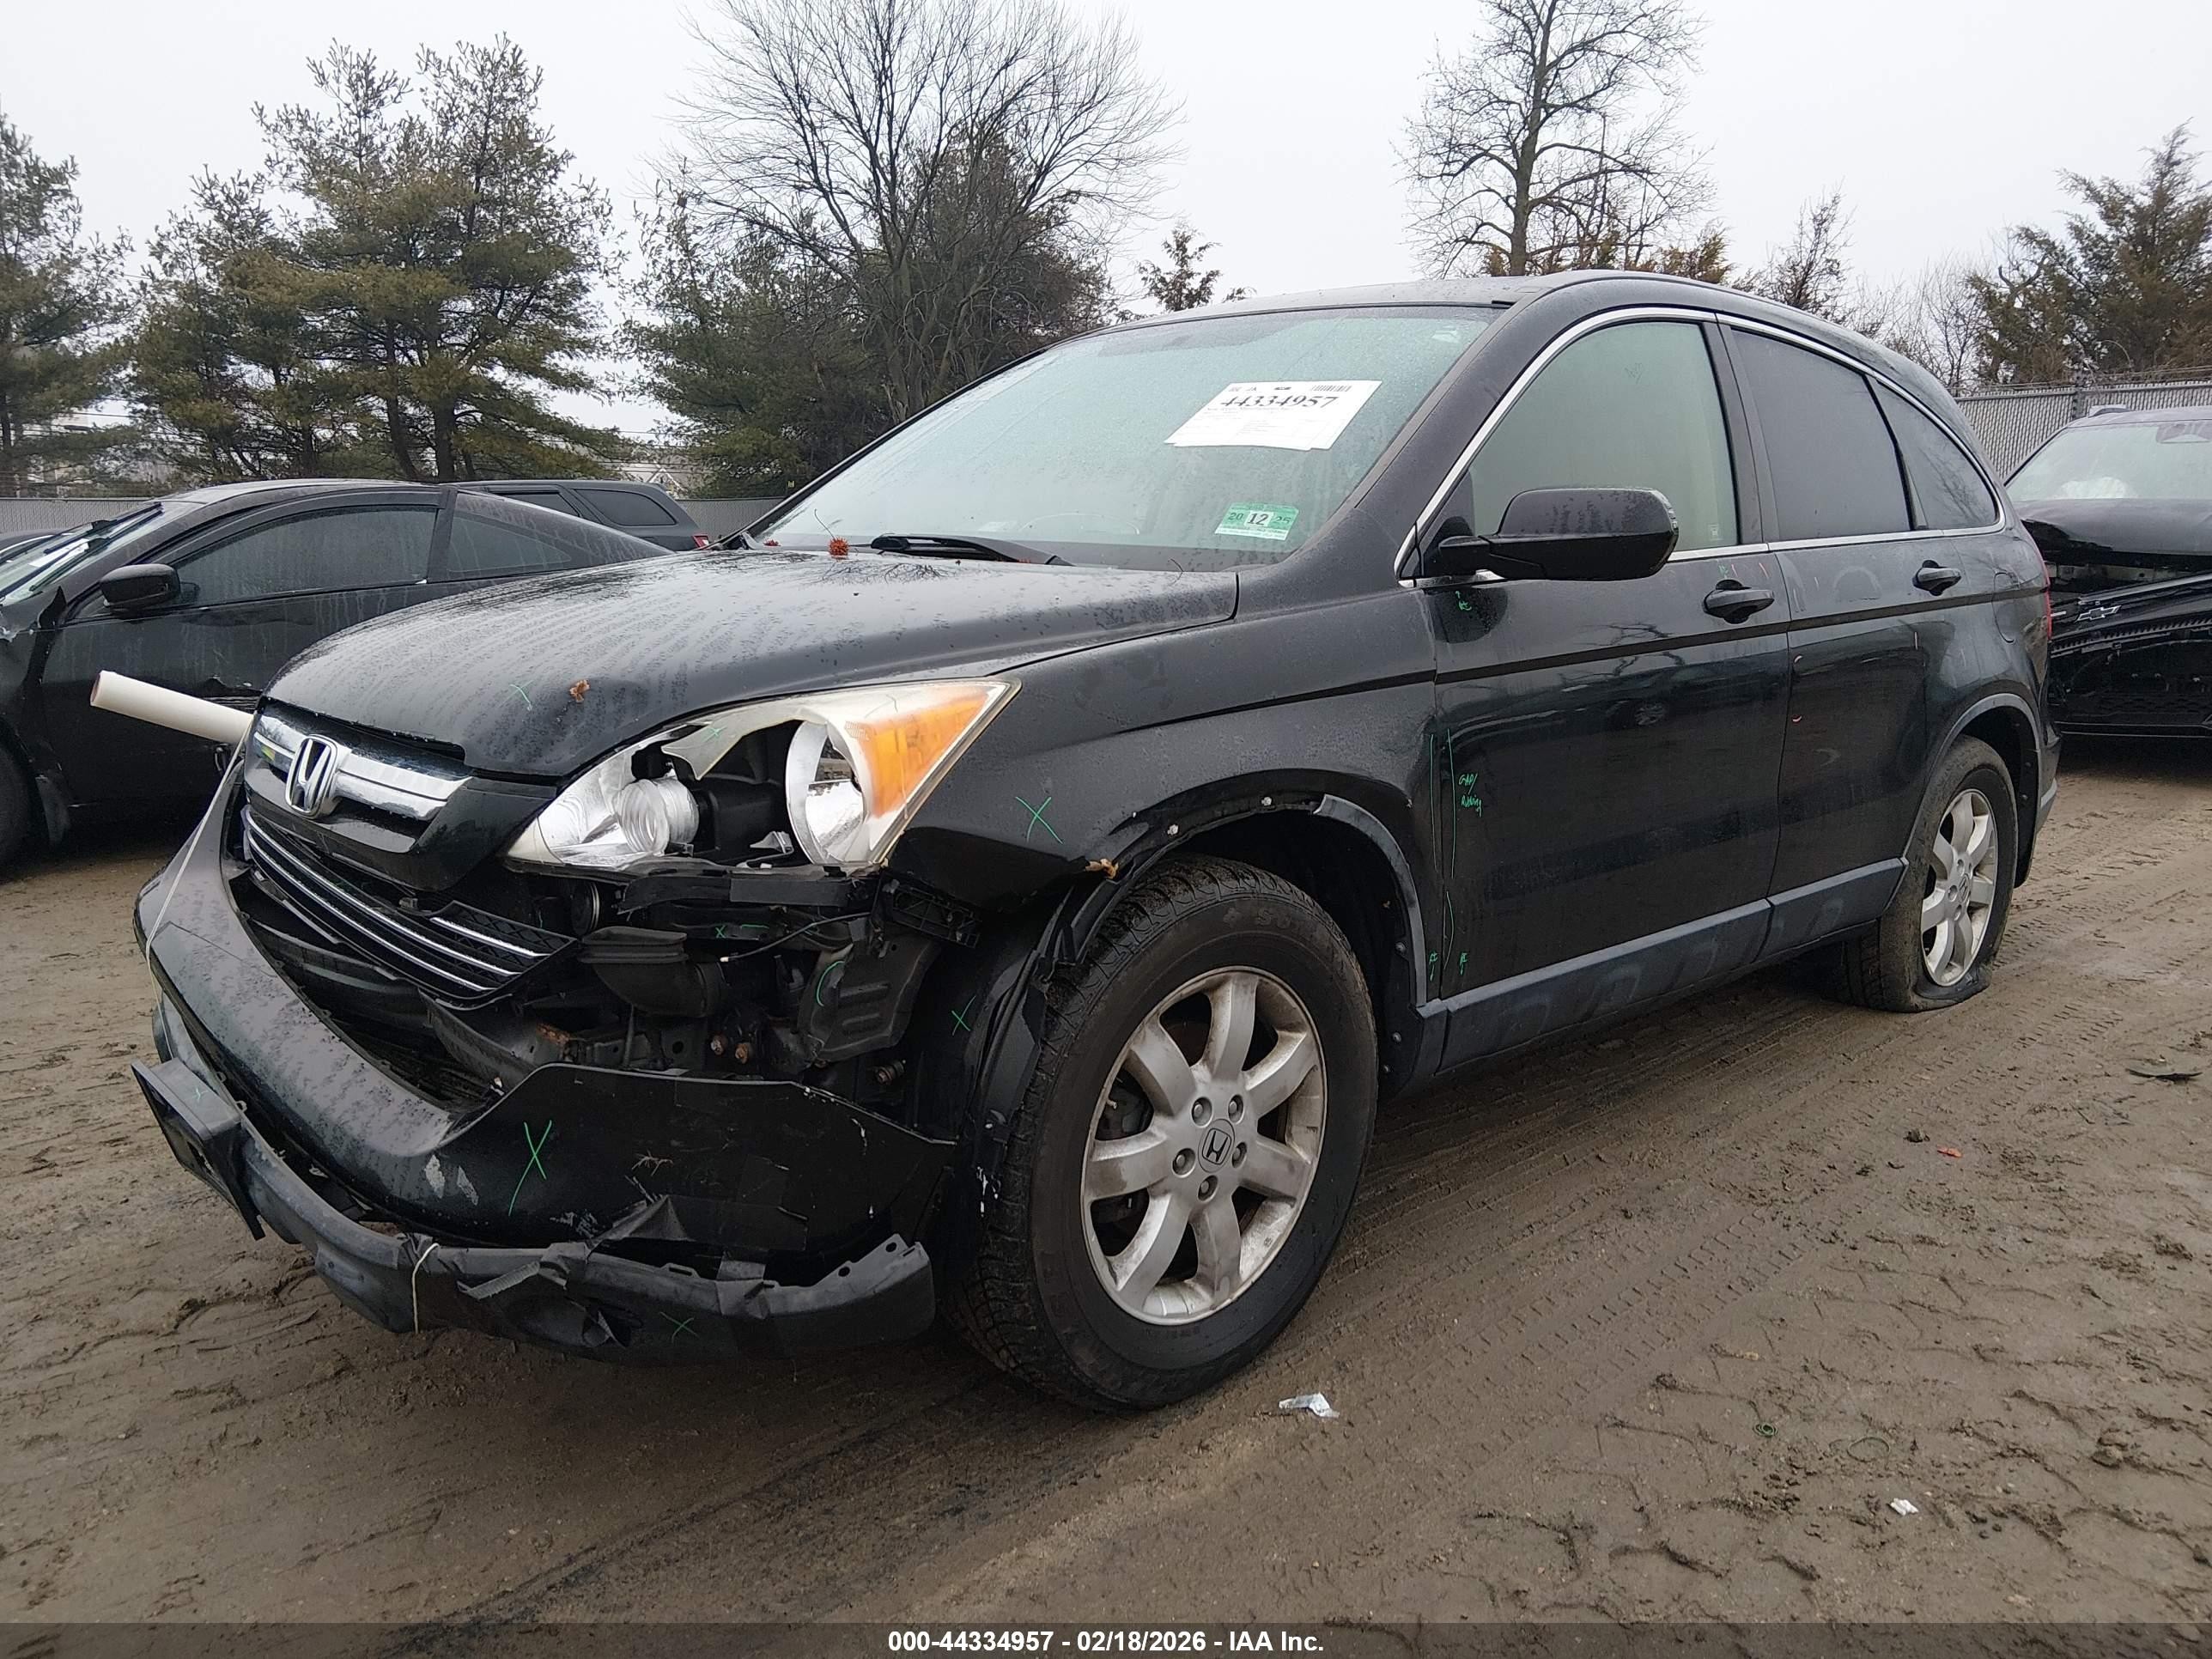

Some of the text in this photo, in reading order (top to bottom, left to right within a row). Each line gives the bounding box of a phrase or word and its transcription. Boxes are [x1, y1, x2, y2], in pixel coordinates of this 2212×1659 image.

[1221, 395, 1339, 408] 44334957
[1228, 512, 1244, 520] 20
[1247, 513, 1269, 526] 12
